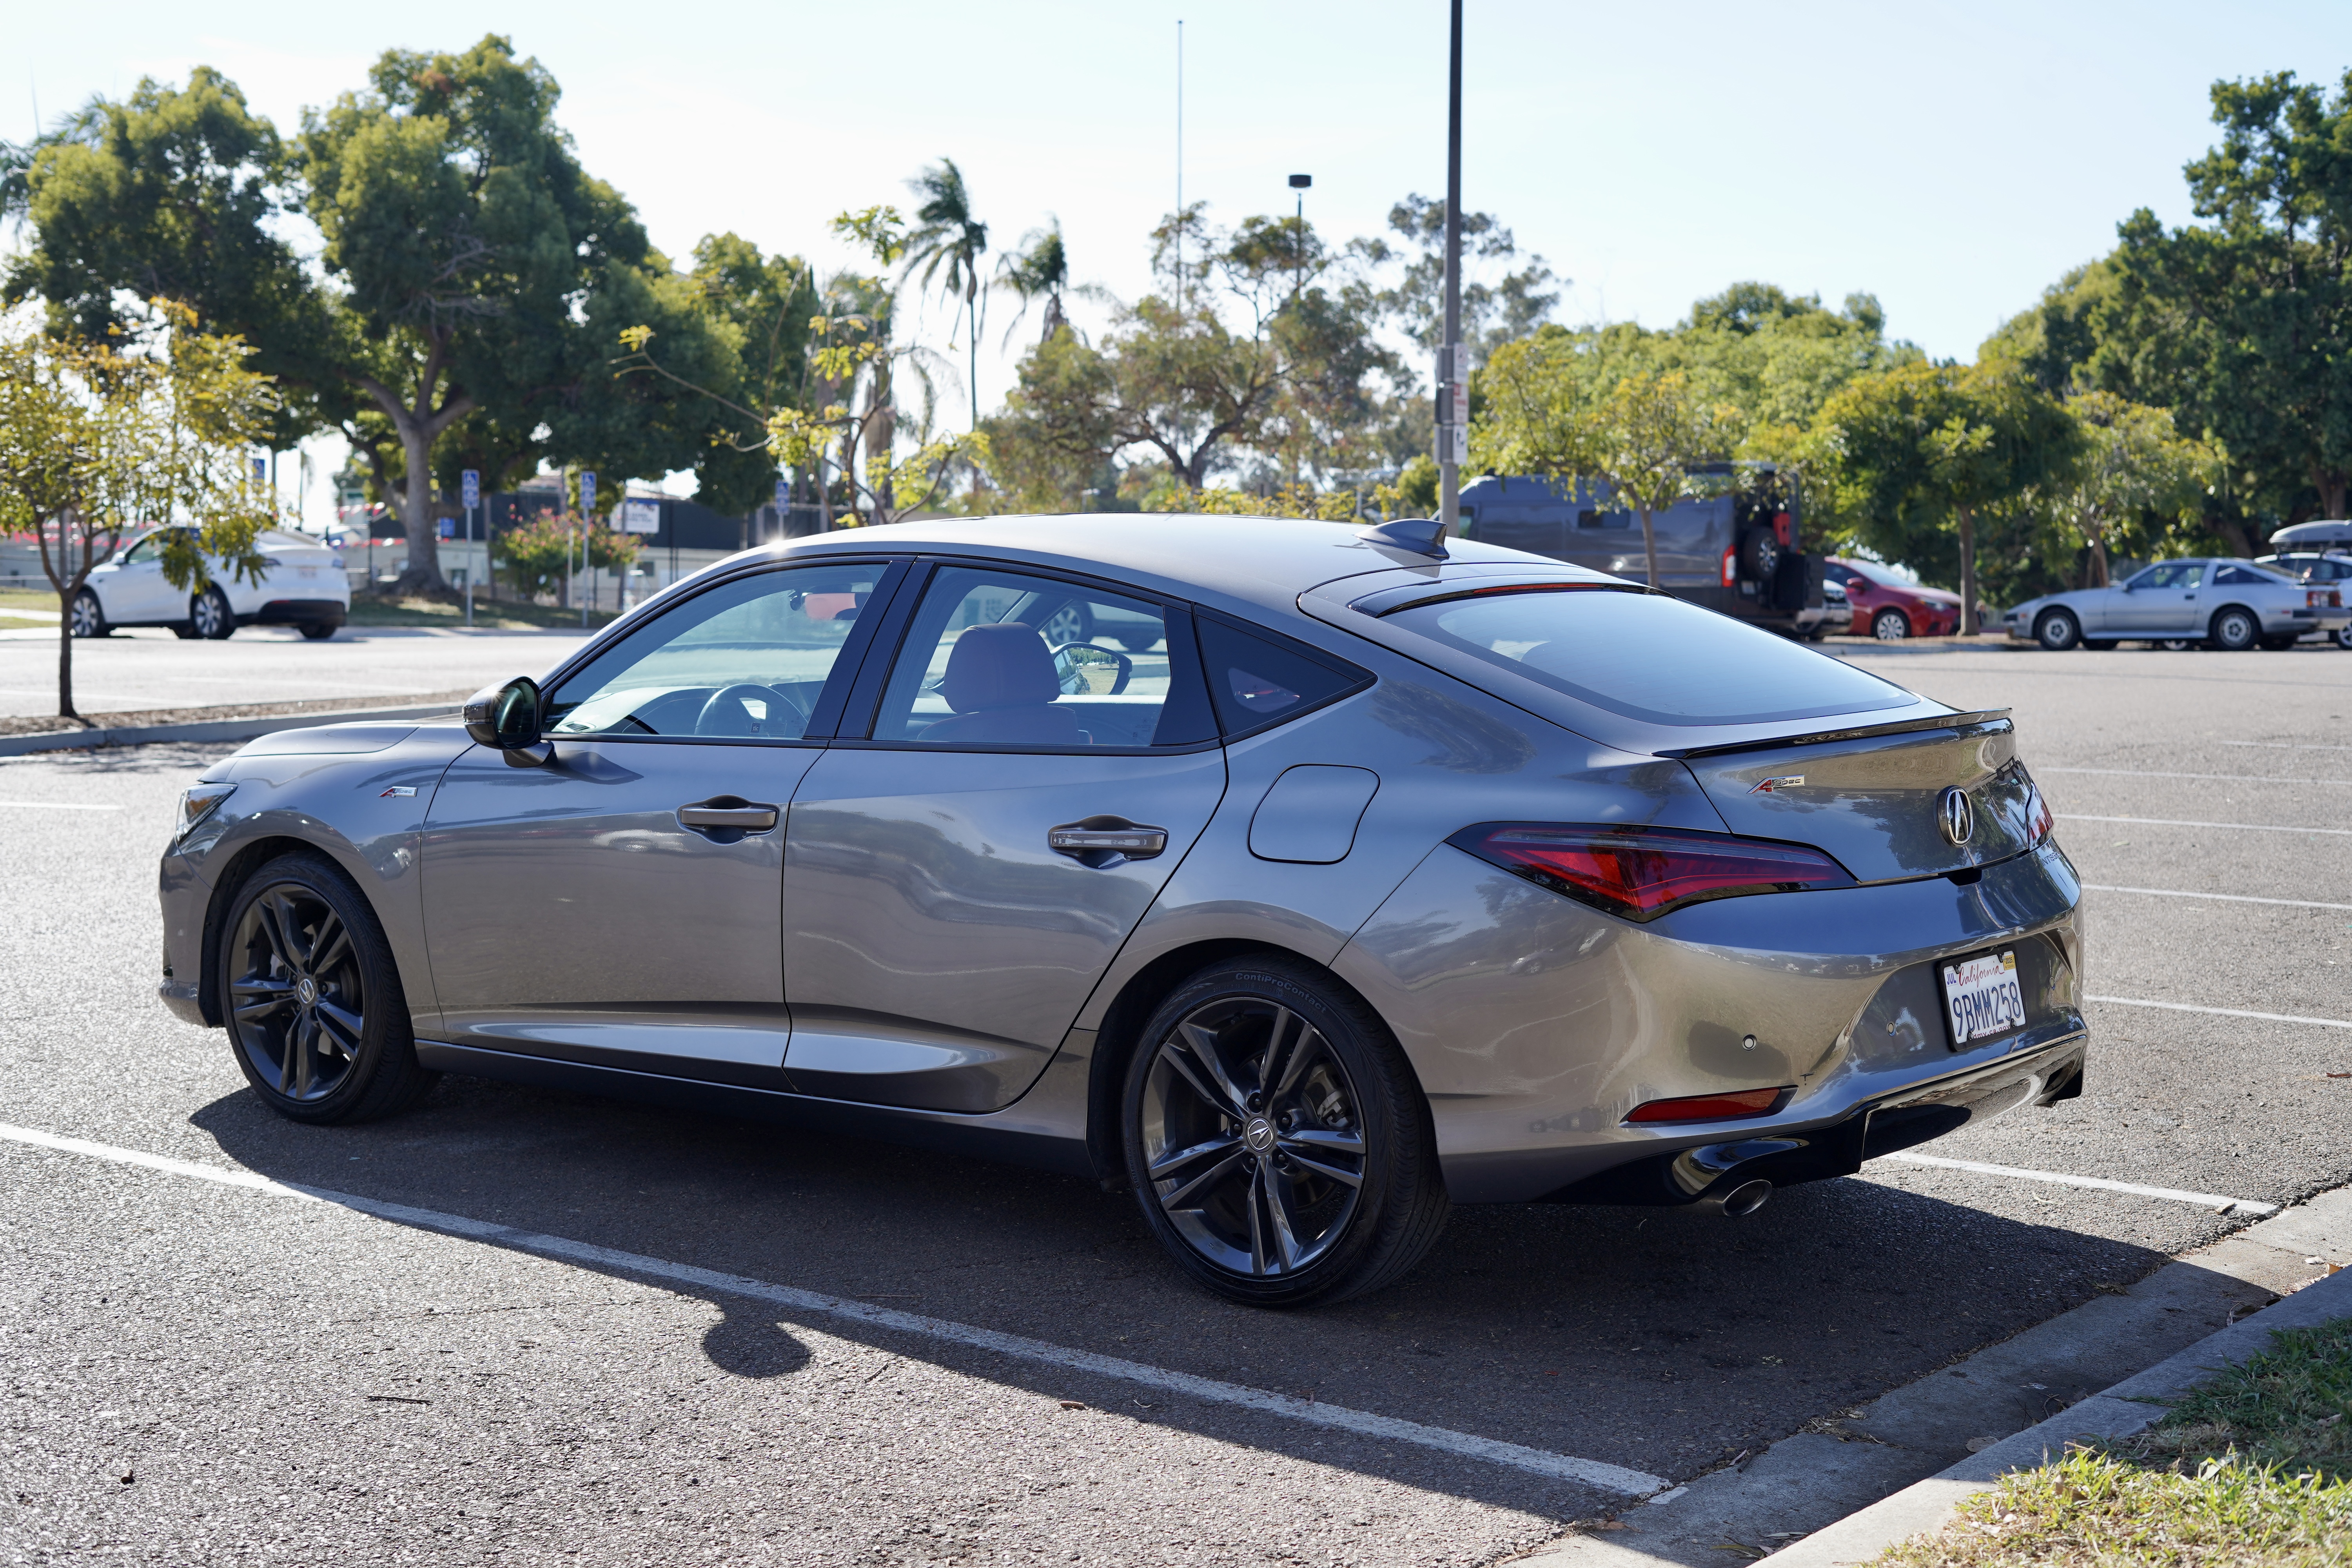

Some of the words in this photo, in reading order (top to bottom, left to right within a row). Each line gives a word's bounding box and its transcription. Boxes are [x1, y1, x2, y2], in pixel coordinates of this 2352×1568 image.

[1947, 973, 1957, 985] JUL
[1958, 960, 2005, 988] California
[1235, 973, 1327, 1014] ContiProContact
[1953, 981, 2021, 1037] 9BMM258
[1973, 1024, 2010, 1039] dmv.ca.gov
